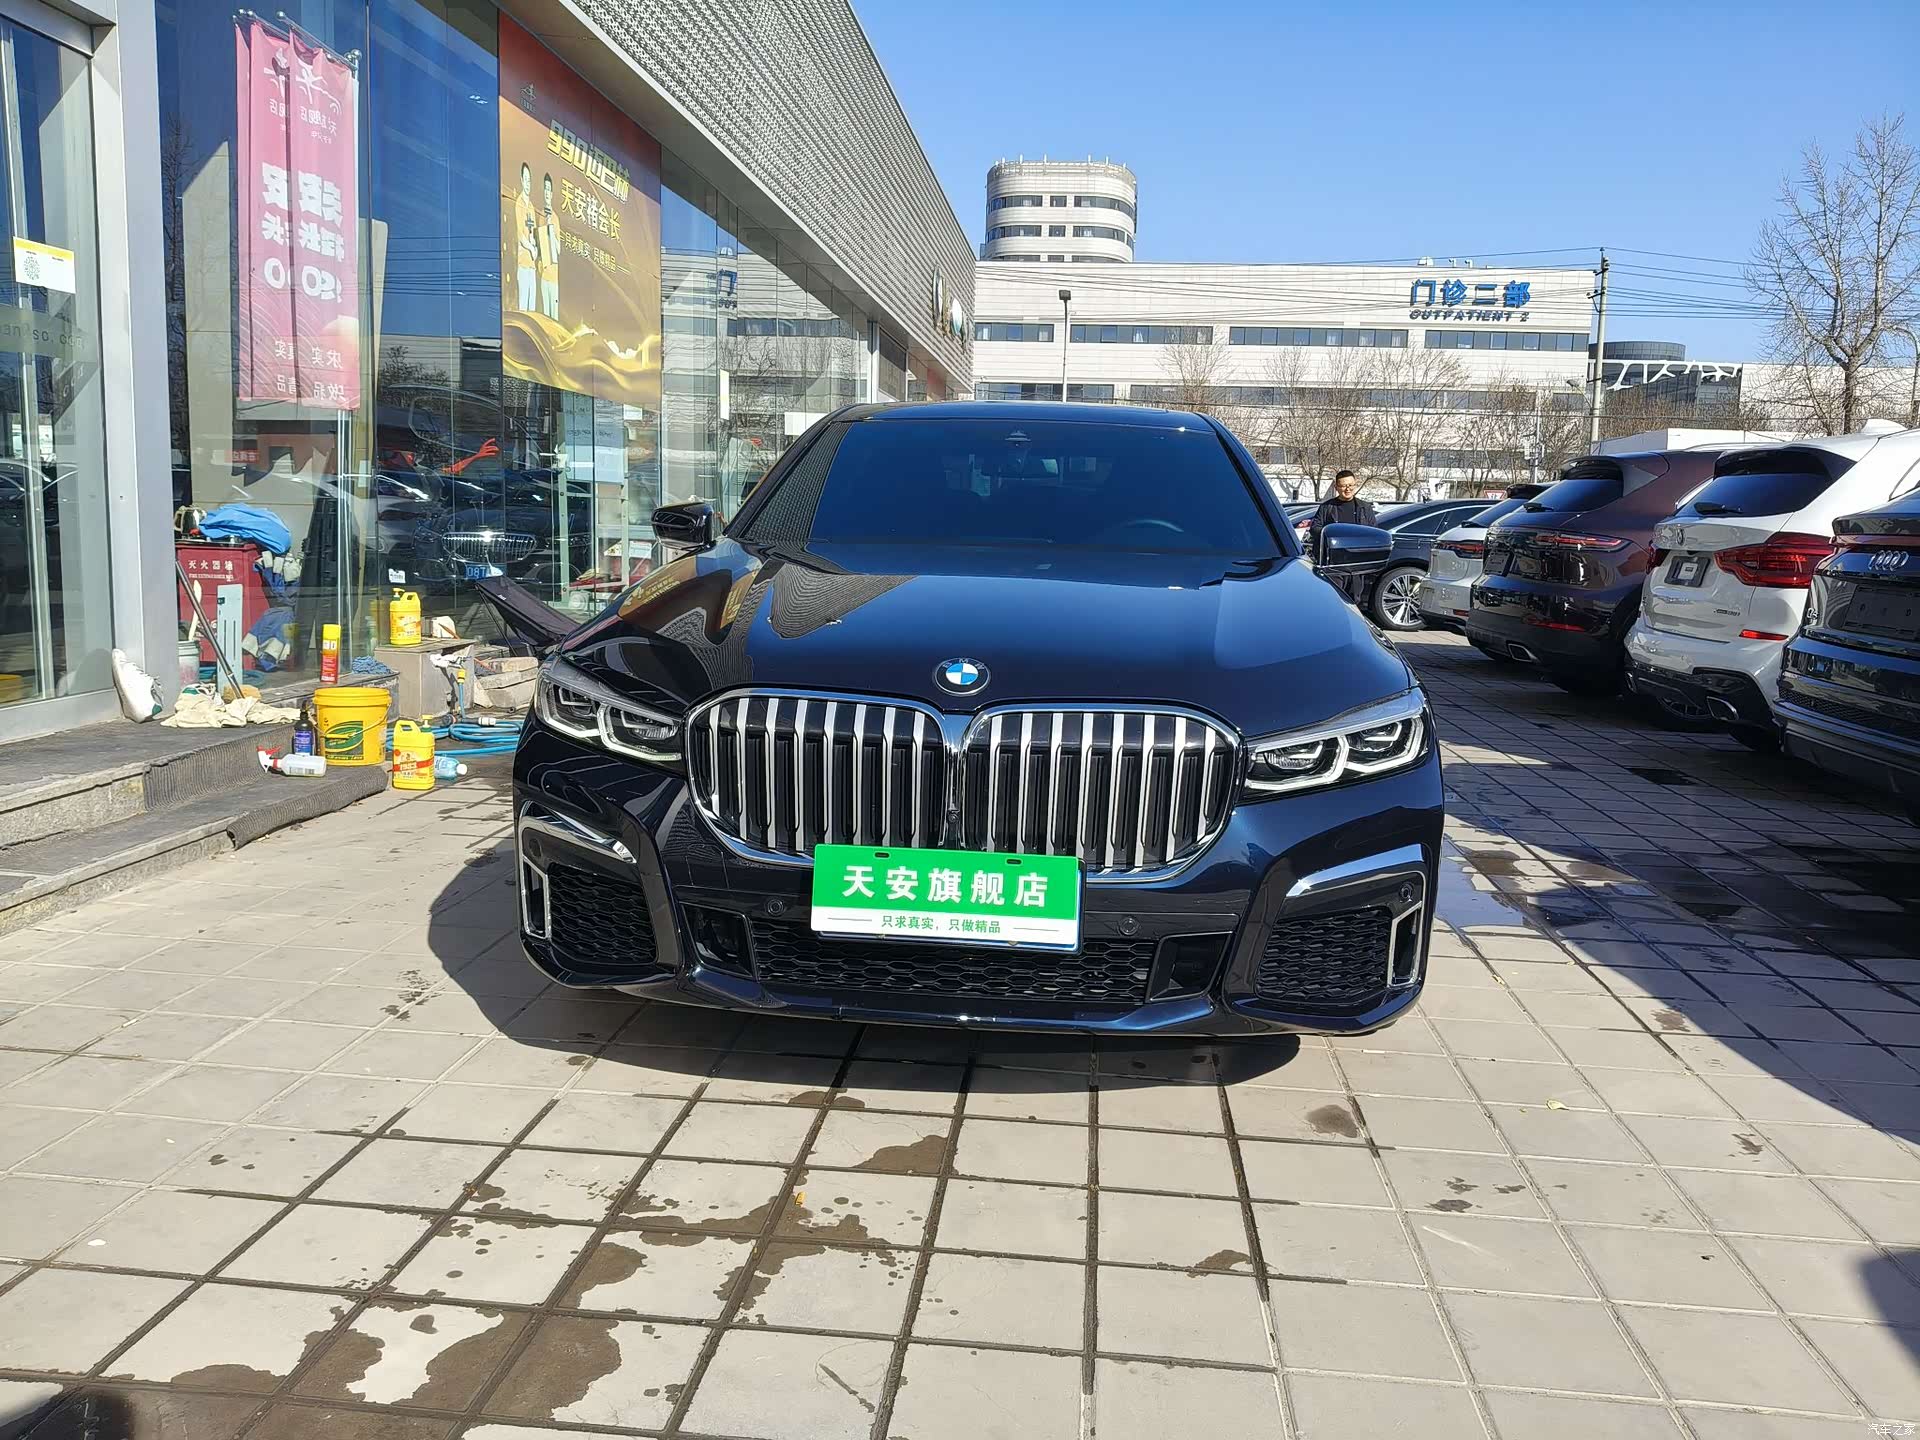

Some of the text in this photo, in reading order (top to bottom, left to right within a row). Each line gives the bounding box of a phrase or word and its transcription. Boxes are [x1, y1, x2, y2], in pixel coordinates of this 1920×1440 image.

[1410, 279, 1530, 308] 门诊二部
[1410, 309, 1530, 322] OUTPATIENT 2
[942, 658, 985, 670] BMW
[842, 865, 1048, 907] 天安旗舰店
